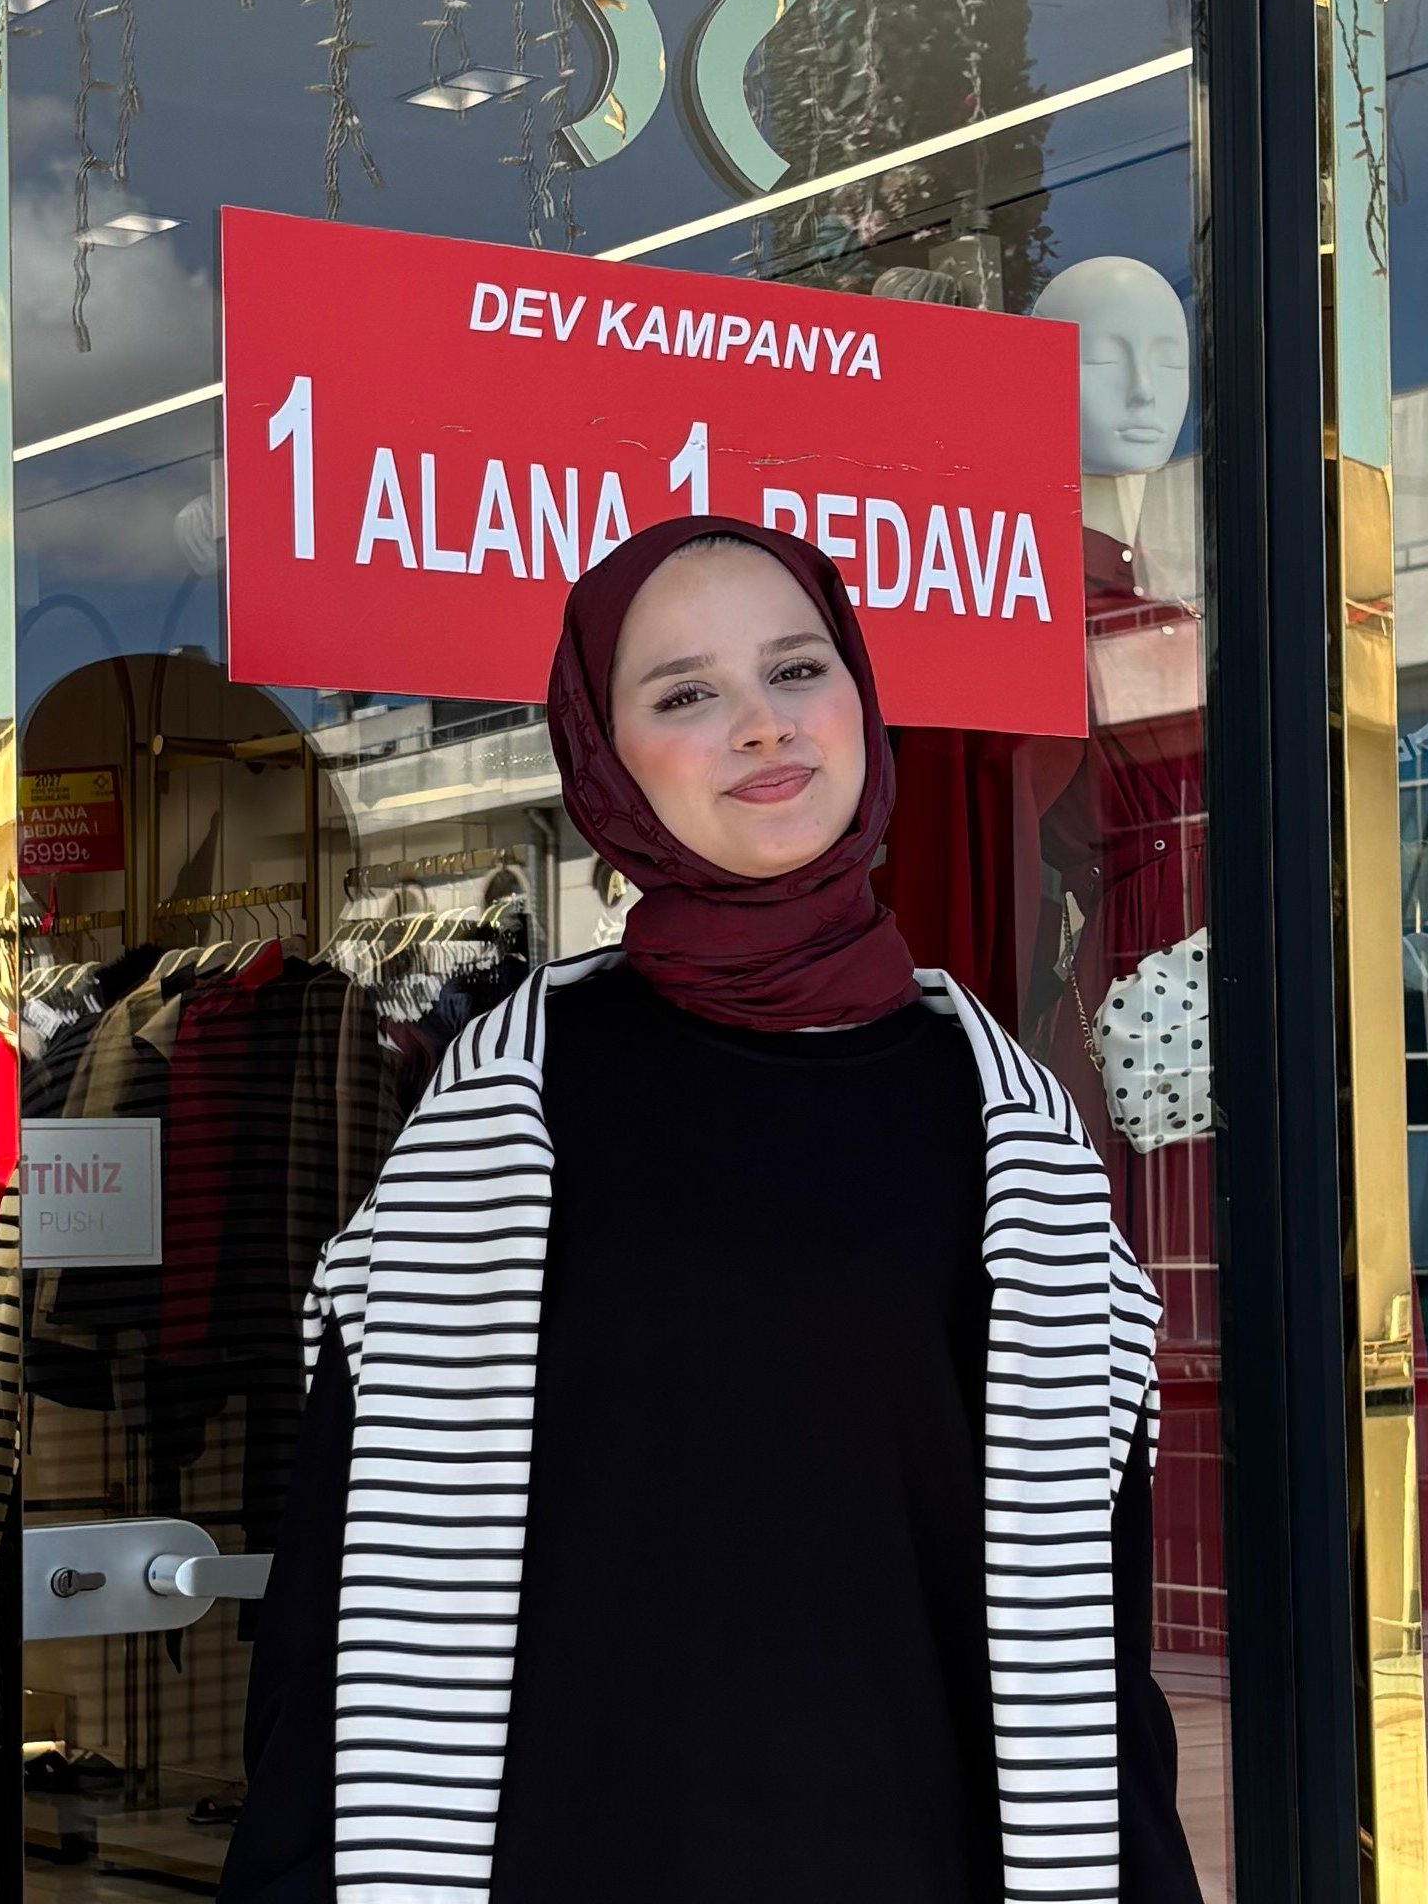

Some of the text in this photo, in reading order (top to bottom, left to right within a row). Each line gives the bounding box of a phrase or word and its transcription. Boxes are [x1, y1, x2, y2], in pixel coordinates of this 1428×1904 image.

[469, 282, 882, 380] DEV KAMPANYA
[268, 375, 315, 560] 1
[355, 447, 632, 584] ALANA
[31, 805, 88, 823] ALANA
[24, 821, 90, 839] BEDAVA
[39, 1211, 105, 1233] PUSH
